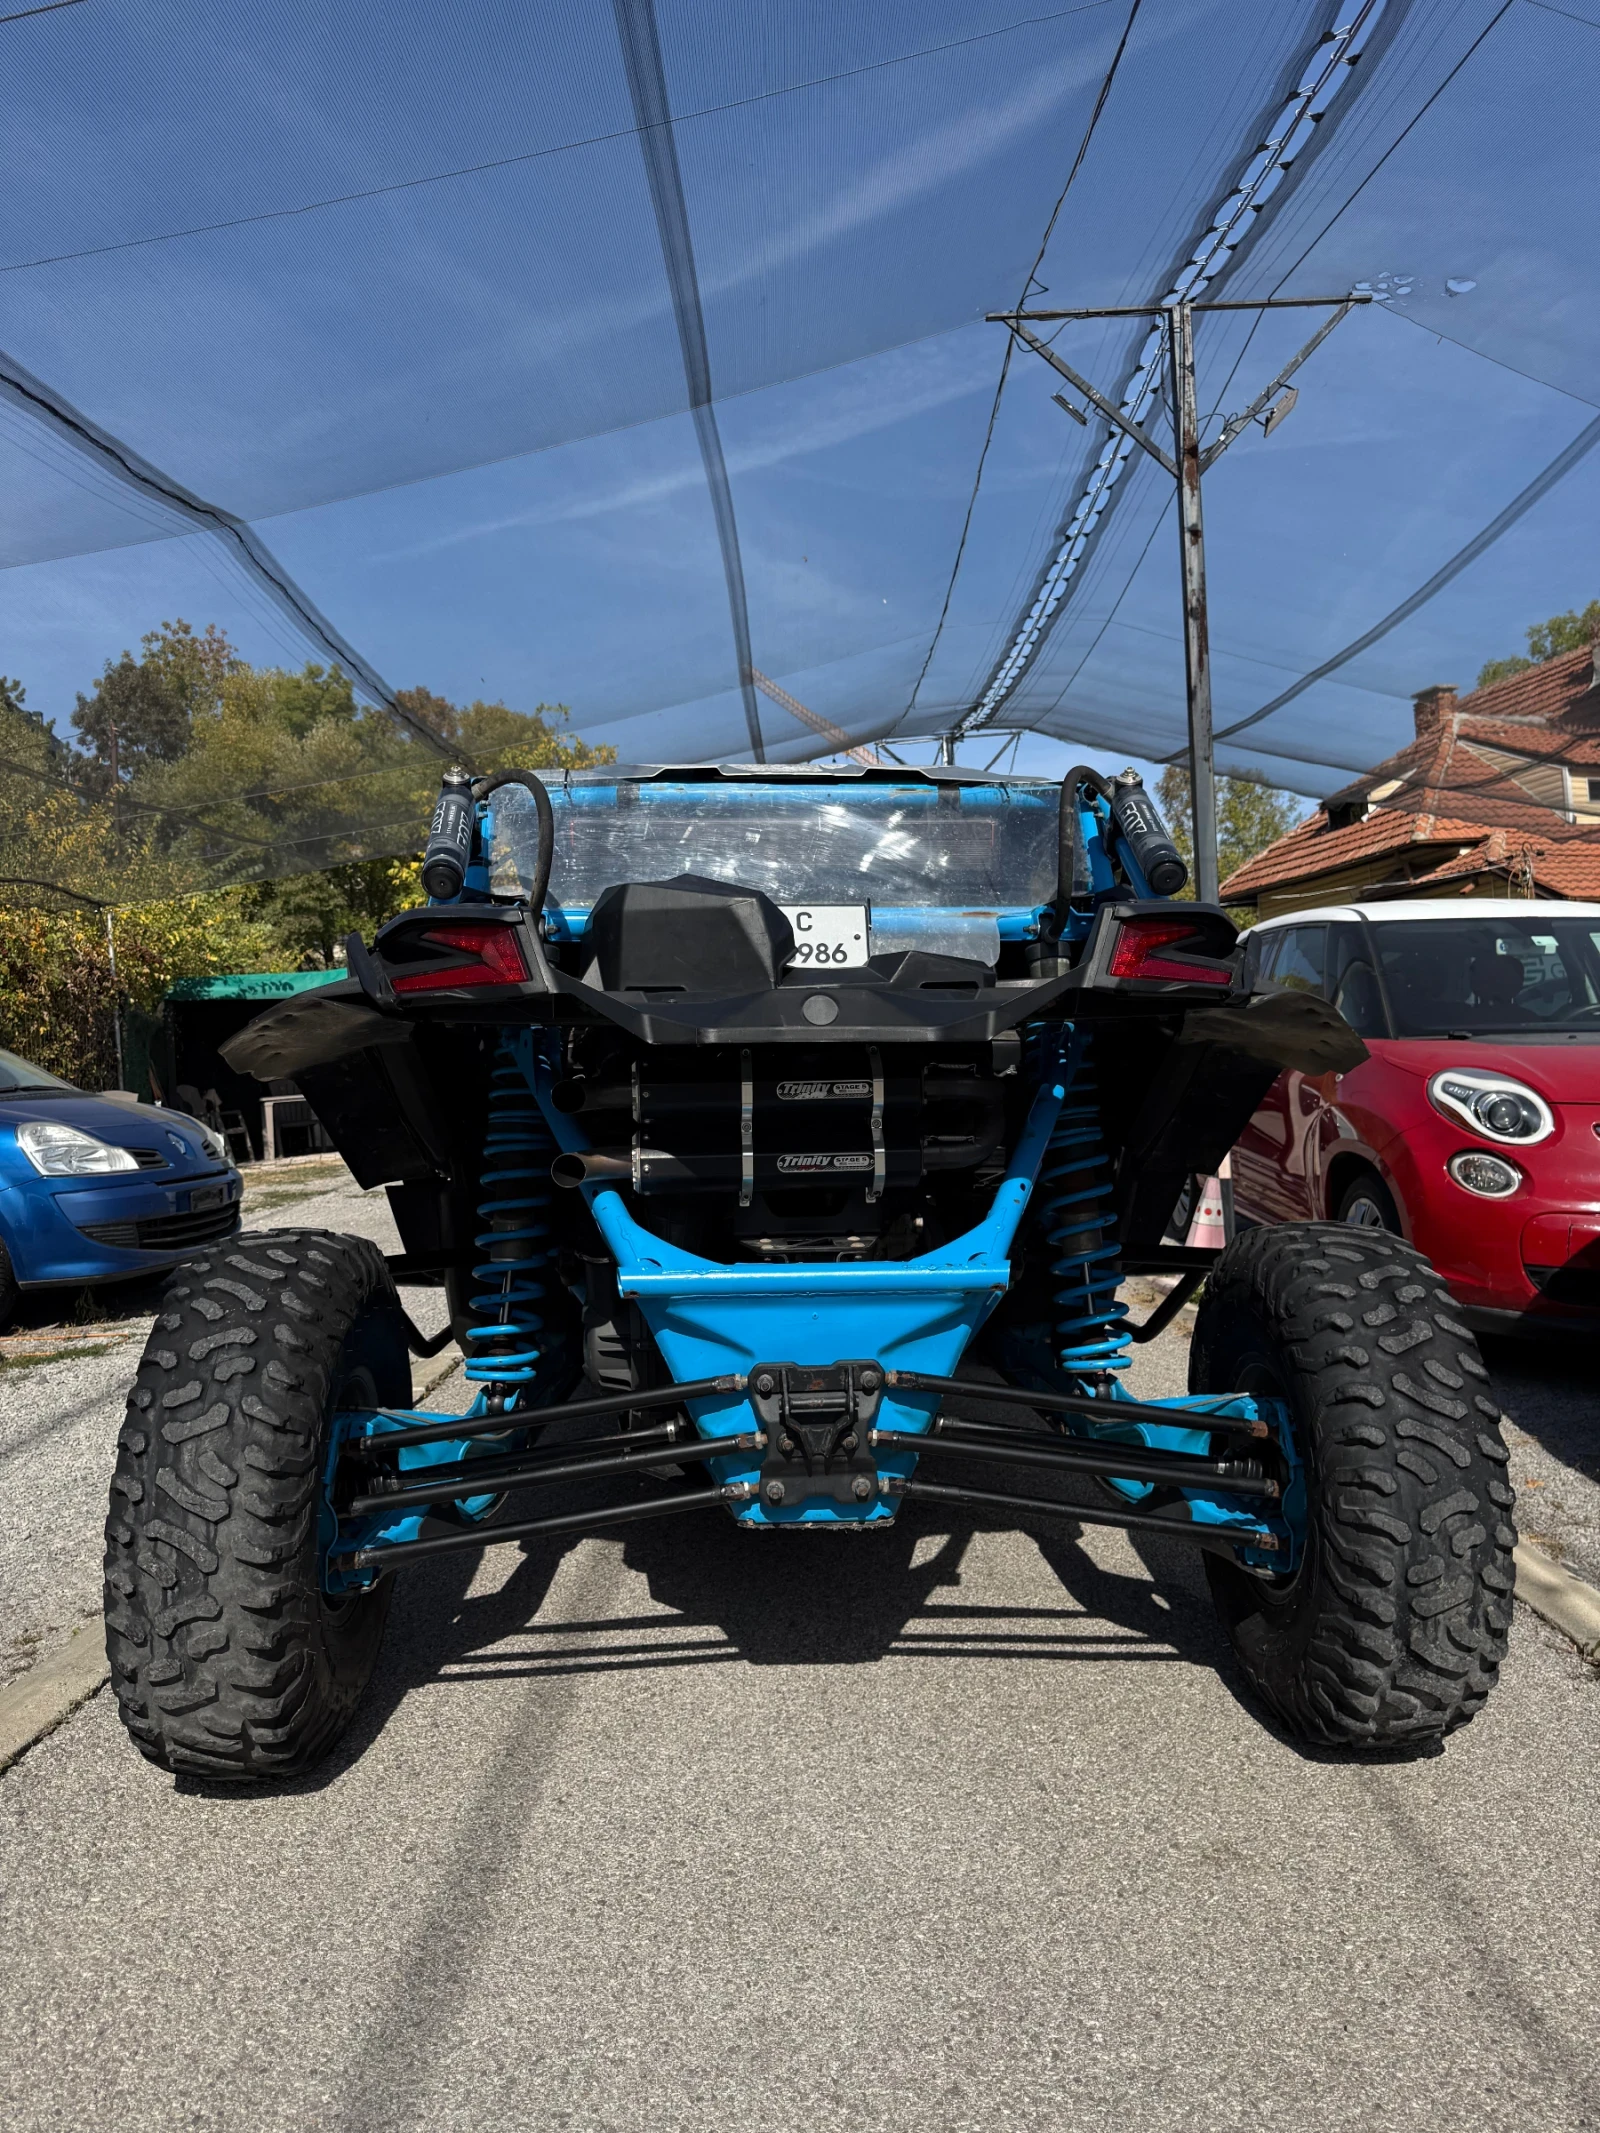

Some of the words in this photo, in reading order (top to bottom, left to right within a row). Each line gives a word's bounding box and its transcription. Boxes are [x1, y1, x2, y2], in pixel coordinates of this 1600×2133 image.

[796, 911, 813, 932] C
[788, 942, 848, 964] 986
[783, 1083, 831, 1095] Trinity
[783, 1155, 832, 1168] Trinity
